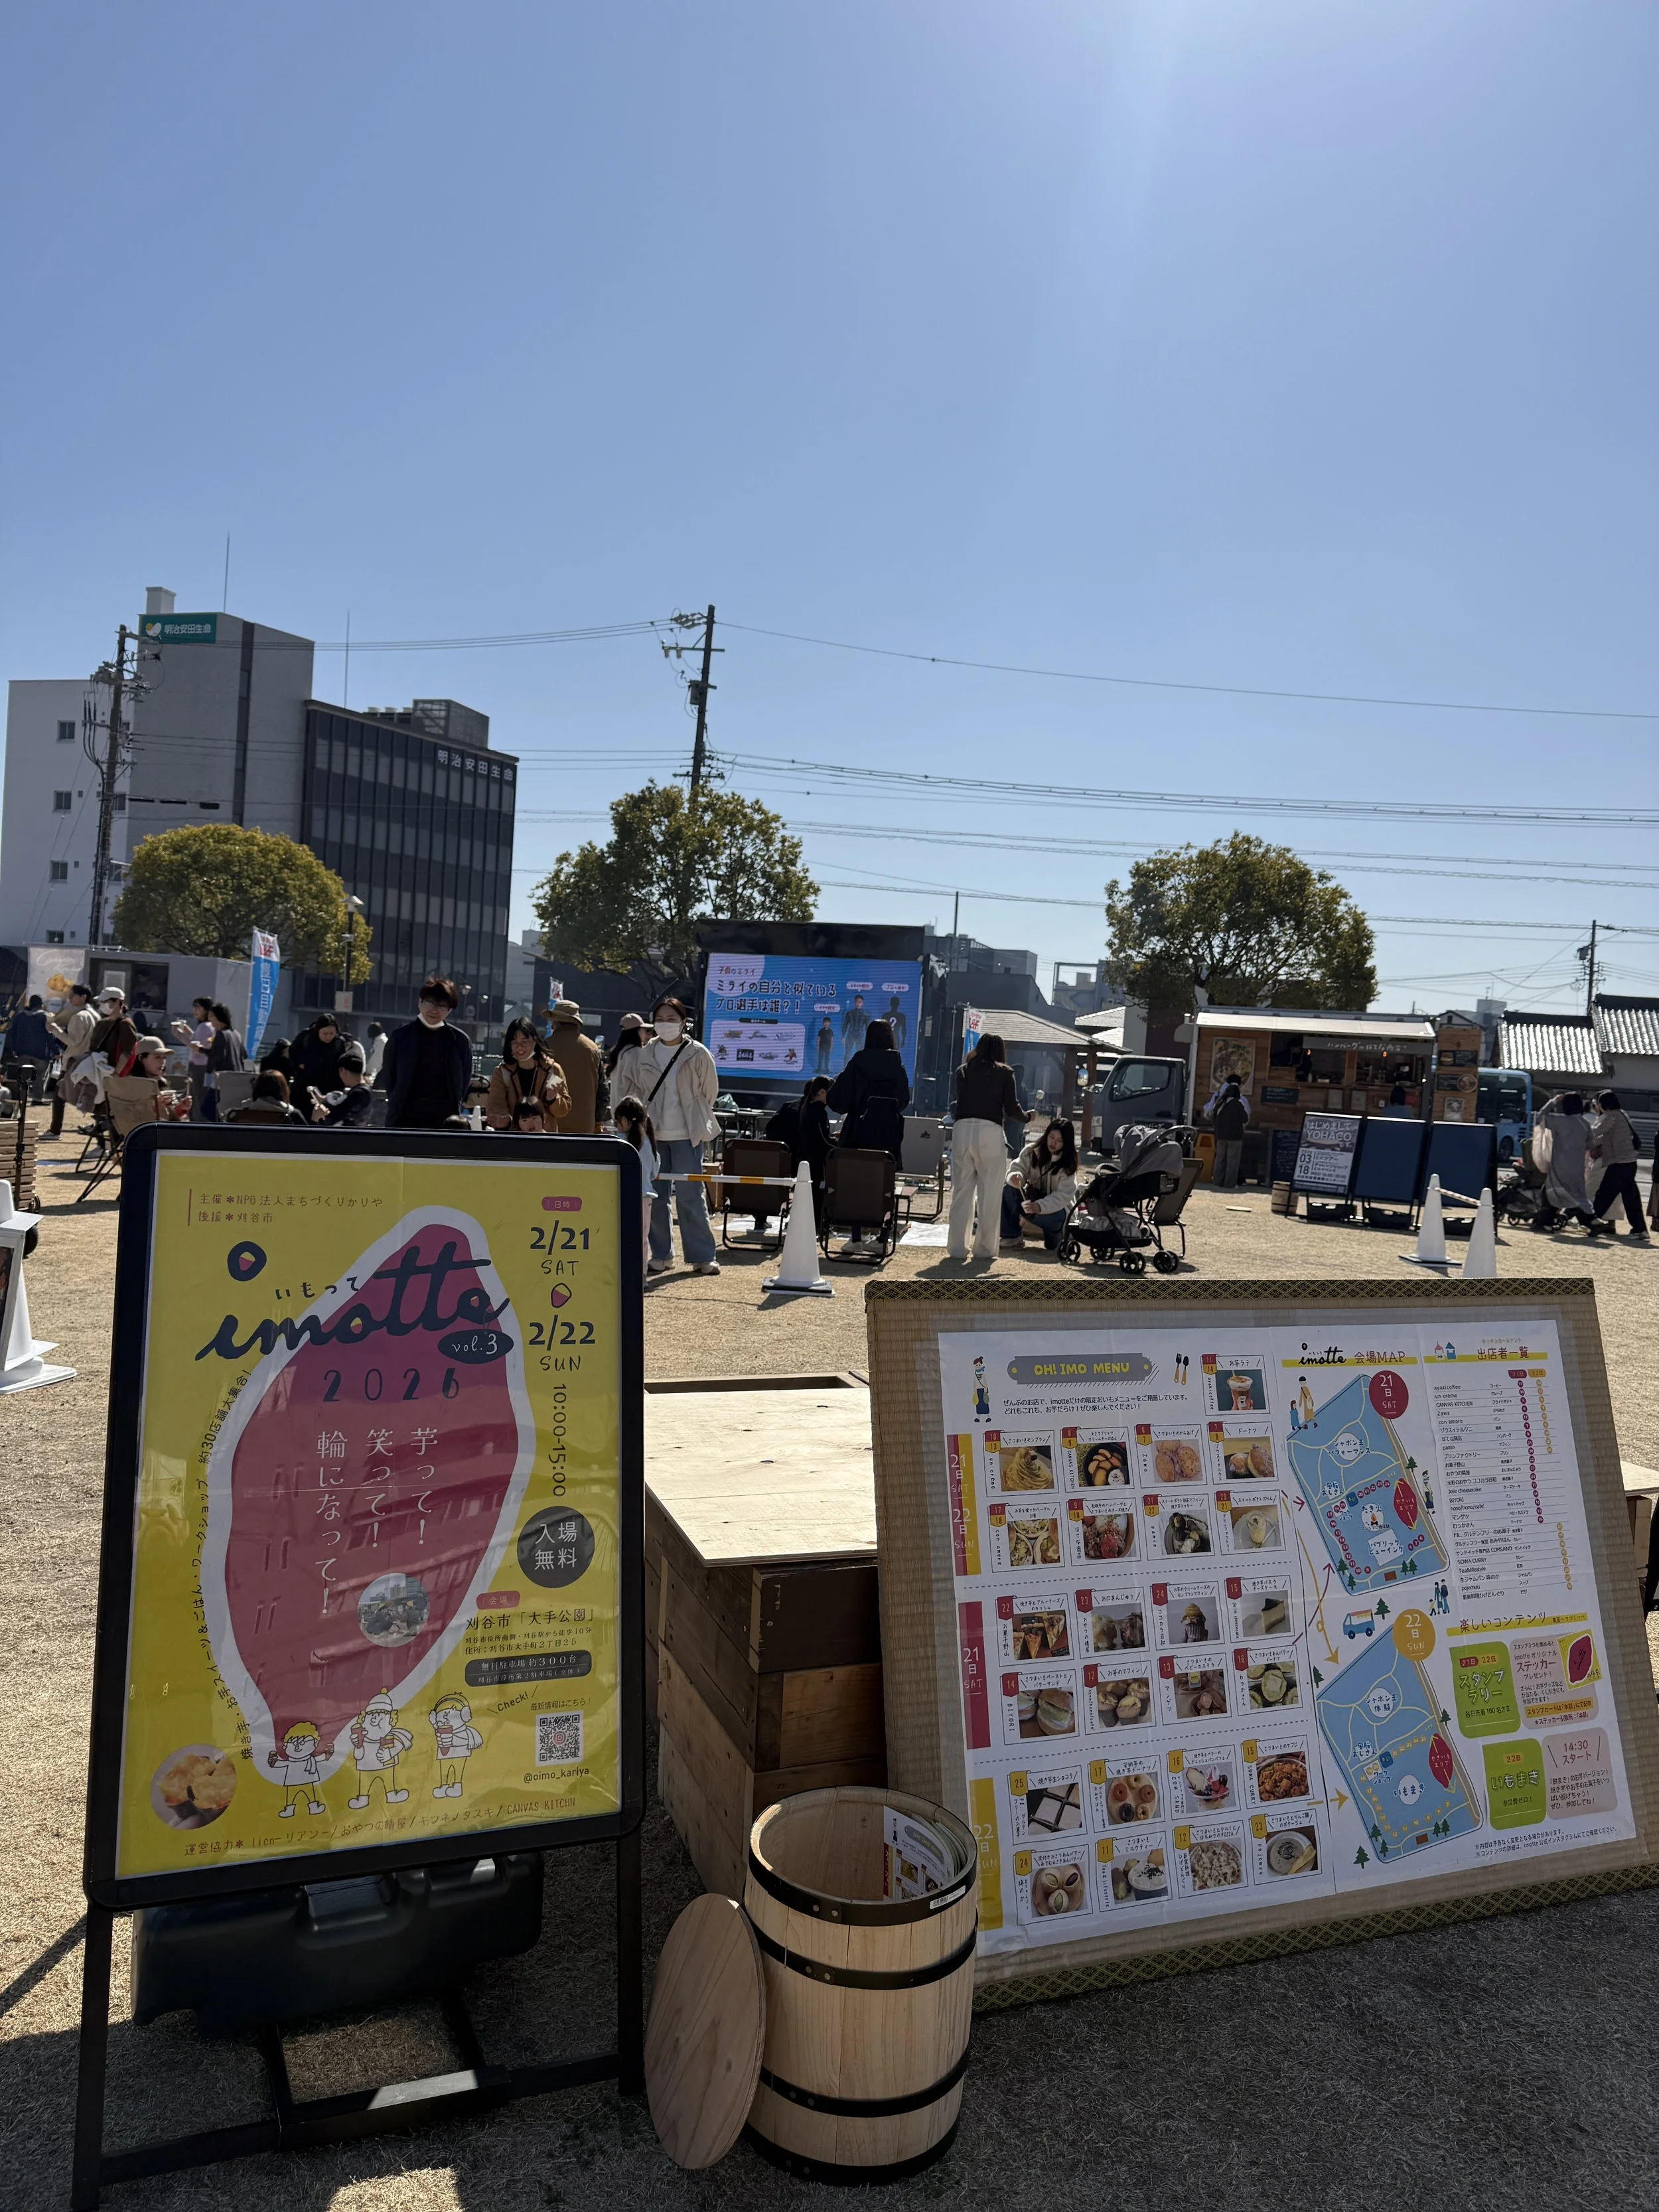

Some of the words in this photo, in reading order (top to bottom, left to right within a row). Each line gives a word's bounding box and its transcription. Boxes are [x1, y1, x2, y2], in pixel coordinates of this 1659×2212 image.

[164, 623, 211, 634] 明治安田生命
[438, 749, 513, 781] 明治安田生命
[716, 979, 836, 997] ミライの自分と似ている
[1299, 1154, 1312, 1163] 03
[1298, 1165, 1309, 1175] 18
[530, 1220, 589, 1255] 2/21
[541, 1260, 579, 1276] SAT
[275, 1276, 359, 1299] いもって
[528, 1314, 596, 1351] 2/22
[451, 1333, 498, 1355] vol.3
[1299, 1343, 1346, 1365] imotte
[1354, 1351, 1406, 1364] 会場MAP
[1477, 1346, 1530, 1361] 出店者一覧
[540, 1355, 581, 1371] SUN
[1033, 1363, 1057, 1375] OH!
[1060, 1363, 1087, 1374] IMO
[1093, 1361, 1130, 1374] MENU
[323, 1367, 460, 1402] 2026
[1379, 1374, 1394, 1387] 21
[1385, 1388, 1392, 1397] 日
[1382, 1400, 1397, 1409] SAT
[548, 1383, 567, 1497] 10:00-15:00
[950, 1454, 966, 1469] 21
[956, 1470, 964, 1479] 日
[365, 1428, 393, 1548] 笑って！
[410, 1428, 438, 1545] 芋って！
[950, 1483, 969, 1493] SAT
[316, 1430, 348, 1614] 輪になって！
[953, 1508, 972, 1523] 22
[535, 1521, 577, 1544] 入場
[960, 1524, 968, 1535] 日
[954, 1539, 974, 1549] SUN
[534, 1547, 577, 1570] 無料
[1156, 1589, 1165, 1599] 24
[1230, 1584, 1238, 1593] 15
[489, 1597, 508, 1605] 会場
[1080, 1595, 1089, 1605] 23
[1001, 1603, 1010, 1613] 22
[465, 1608, 594, 1631] 刈谷市「大手公園」
[1404, 1614, 1421, 1627] 22
[1460, 1611, 1547, 1633] 楽しいコンテンツ
[1411, 1629, 1419, 1638] 日
[963, 1646, 980, 1662] 21
[1238, 1654, 1246, 1664] 16
[1163, 1662, 1171, 1672] 13
[1462, 1658, 1475, 1666] 21日
[1516, 1659, 1557, 1673] ステッカー
[968, 1664, 977, 1674] 日
[1088, 1671, 1096, 1680] 12
[1107, 1667, 1141, 1676] お芋のマフィン
[964, 1679, 983, 1689] SAT
[1007, 1680, 1015, 1689] 14
[1459, 1668, 1506, 1689] スタンプ
[497, 1691, 529, 1712] Check!
[1468, 1689, 1503, 1704] ラリー
[1007, 1703, 1015, 1732] BIYORI
[1246, 1747, 1255, 1756] 15
[1563, 1739, 1589, 1753] 14:30
[1173, 1757, 1181, 1766] 16
[1562, 1752, 1592, 1766] スタート
[524, 1767, 589, 1784] @oimo_kariya
[1094, 1767, 1102, 1778] 17
[1014, 1778, 1025, 1789] 25
[1490, 1769, 1540, 1791] いもまき
[1394, 1783, 1425, 1796] いもまき
[507, 1801, 539, 1814] CANVAS
[974, 1824, 994, 1839] 22
[1255, 1822, 1263, 1831] 23
[1179, 1833, 1187, 1842] 12
[980, 1842, 989, 1853] 日
[1102, 1846, 1110, 1856] 11
[1019, 1858, 1029, 1868] 24
